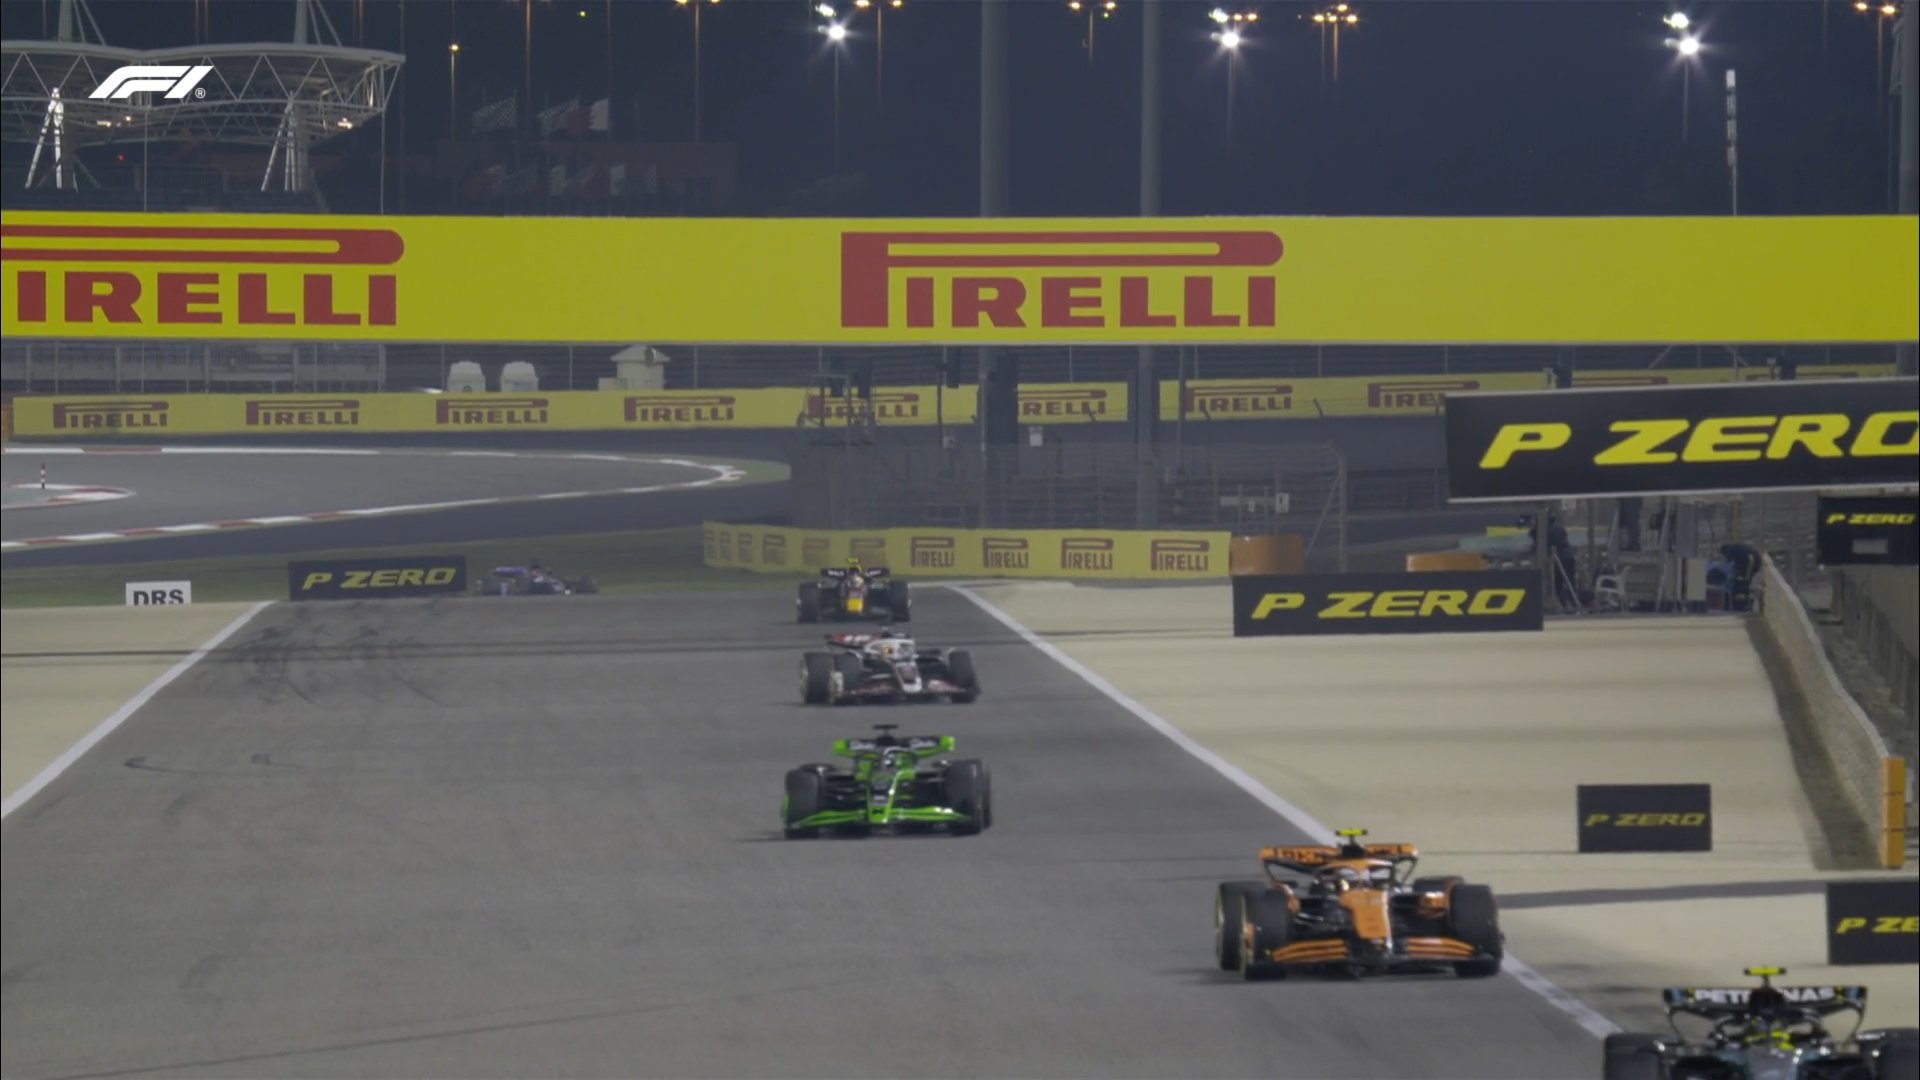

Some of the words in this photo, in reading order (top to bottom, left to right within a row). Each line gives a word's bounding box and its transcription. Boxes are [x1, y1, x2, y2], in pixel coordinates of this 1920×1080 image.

[841, 231, 1284, 328] PIRELLI
[436, 398, 549, 424] PIRELLI
[624, 396, 736, 422] PIRELLI
[1186, 385, 1293, 412] PIRELLI
[53, 401, 169, 428] PIRELLI
[245, 400, 360, 426] PIRELLI
[1479, 423, 1571, 469] P
[1593, 410, 1919, 465] ZERO
[1825, 513, 1846, 525] P
[1848, 512, 1916, 525] ZERO
[910, 536, 954, 568] PIRELLI
[982, 537, 1029, 569] PIRELLI
[1061, 537, 1114, 570] PIRELLI
[1151, 539, 1210, 571] PIRELLI
[302, 572, 333, 590] P
[341, 567, 456, 588] ZERO
[133, 589, 184, 605] DRS
[1251, 592, 1305, 619] P
[1318, 588, 1526, 618] ZERO
[1585, 813, 1610, 827] P
[1614, 813, 1706, 827] ZERO
[1836, 917, 1866, 934] P
